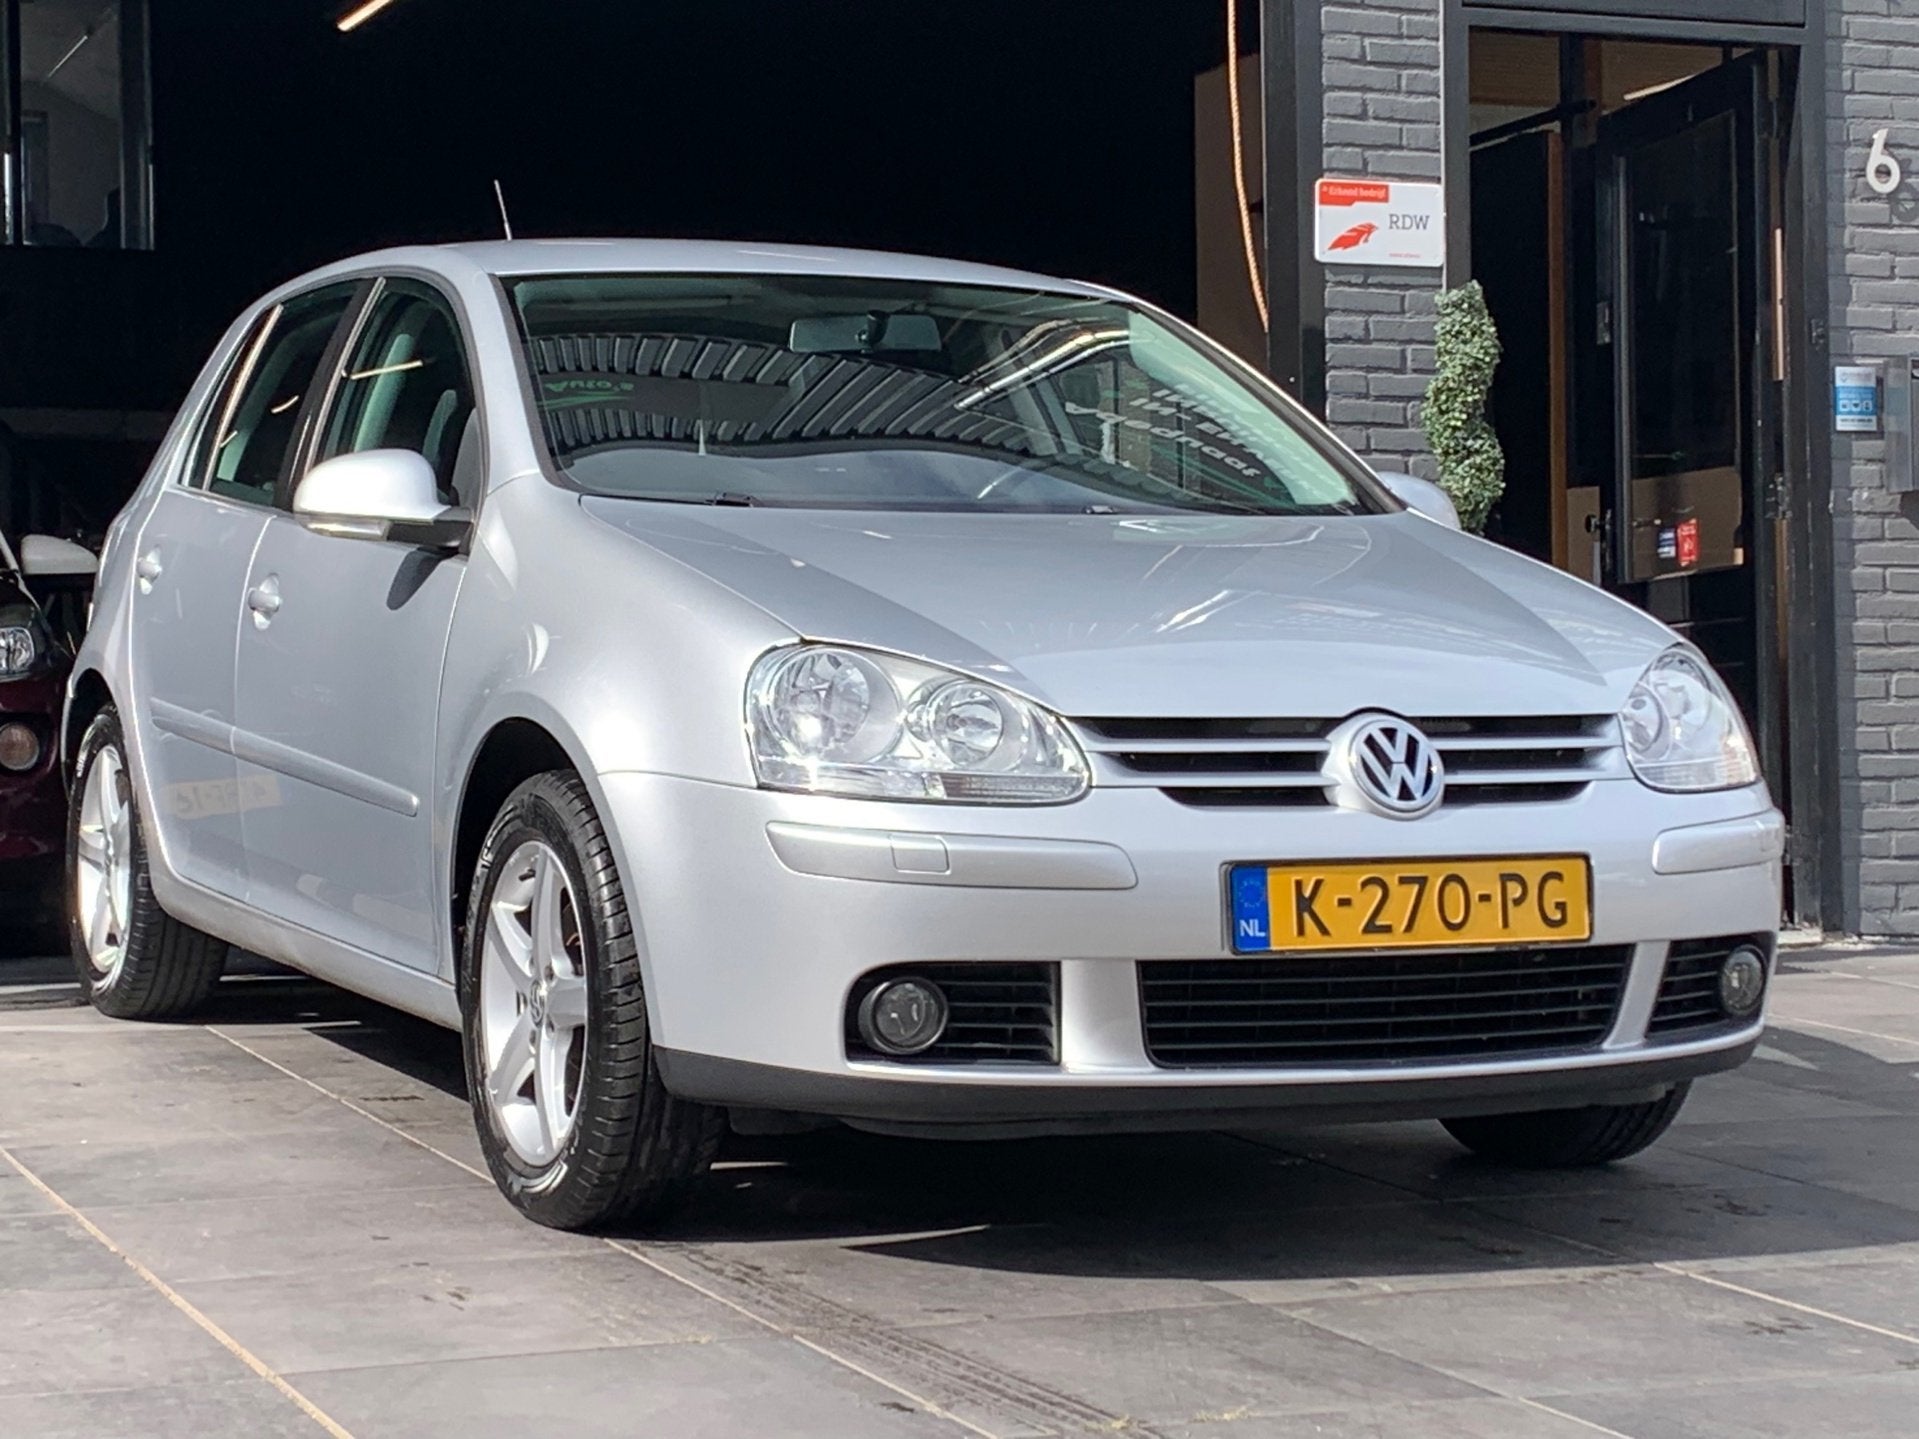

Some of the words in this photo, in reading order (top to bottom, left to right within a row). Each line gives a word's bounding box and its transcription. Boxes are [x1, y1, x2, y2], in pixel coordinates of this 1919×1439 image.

[1866, 128, 1900, 194] 6
[1388, 213, 1430, 231] RDW
[1293, 871, 1568, 938] K-270-PG
[1239, 919, 1266, 938] NL
